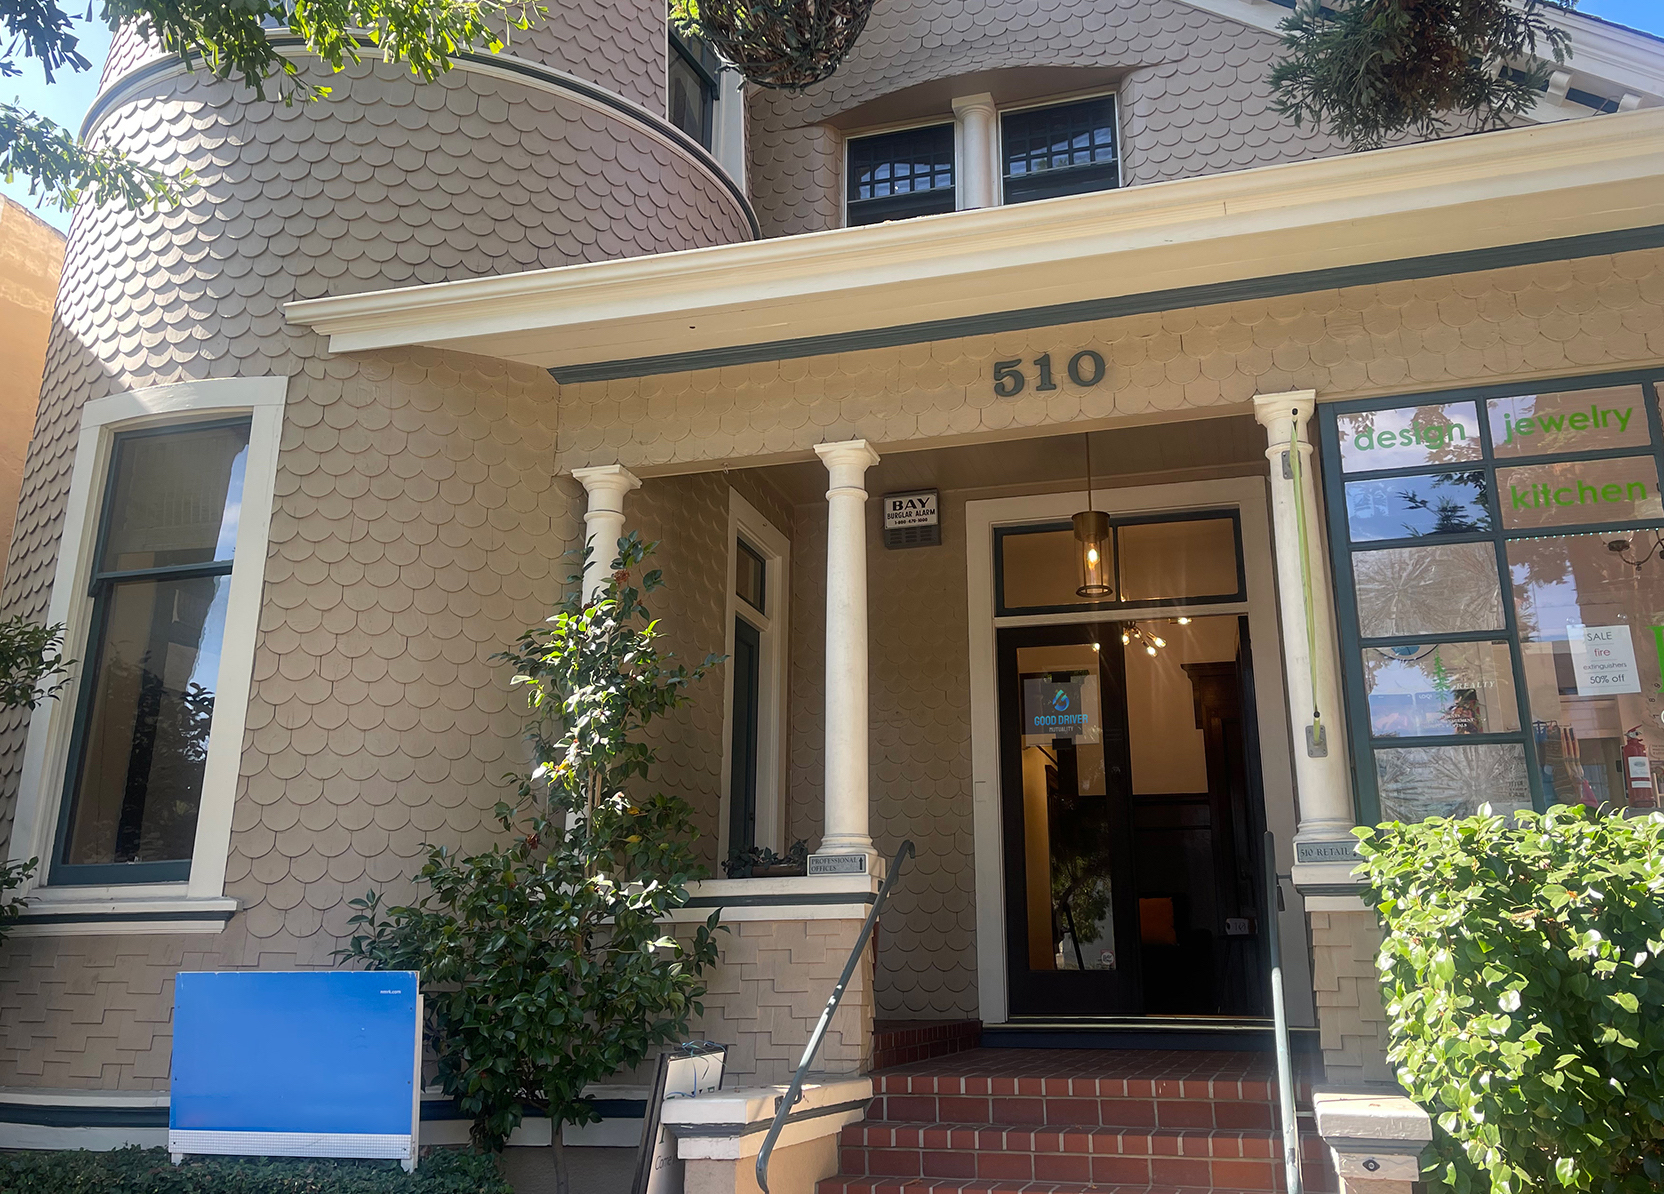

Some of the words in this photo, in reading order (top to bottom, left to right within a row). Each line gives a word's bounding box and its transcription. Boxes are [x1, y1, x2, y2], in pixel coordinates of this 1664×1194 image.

[993, 350, 1106, 397] 510
[1503, 404, 1633, 444] jewelry
[1353, 420, 1467, 451] design
[1510, 479, 1647, 510] kitchen
[892, 497, 930, 511] BAY
[887, 511, 913, 519] BURGLAR
[915, 509, 935, 517] ALARM
[1586, 631, 1612, 641] SALE
[1594, 648, 1611, 657] fire
[1583, 662, 1627, 670] extinguishers
[1590, 674, 1609, 684] 50%
[1611, 674, 1625, 683] off
[1456, 680, 1495, 690] REALTY
[1034, 715, 1057, 726] GOOD
[1058, 714, 1089, 725] DRIVER
[1300, 848, 1313, 857] 510
[1316, 847, 1350, 857] RETAIL
[811, 857, 857, 865] PROFESSIONAL
